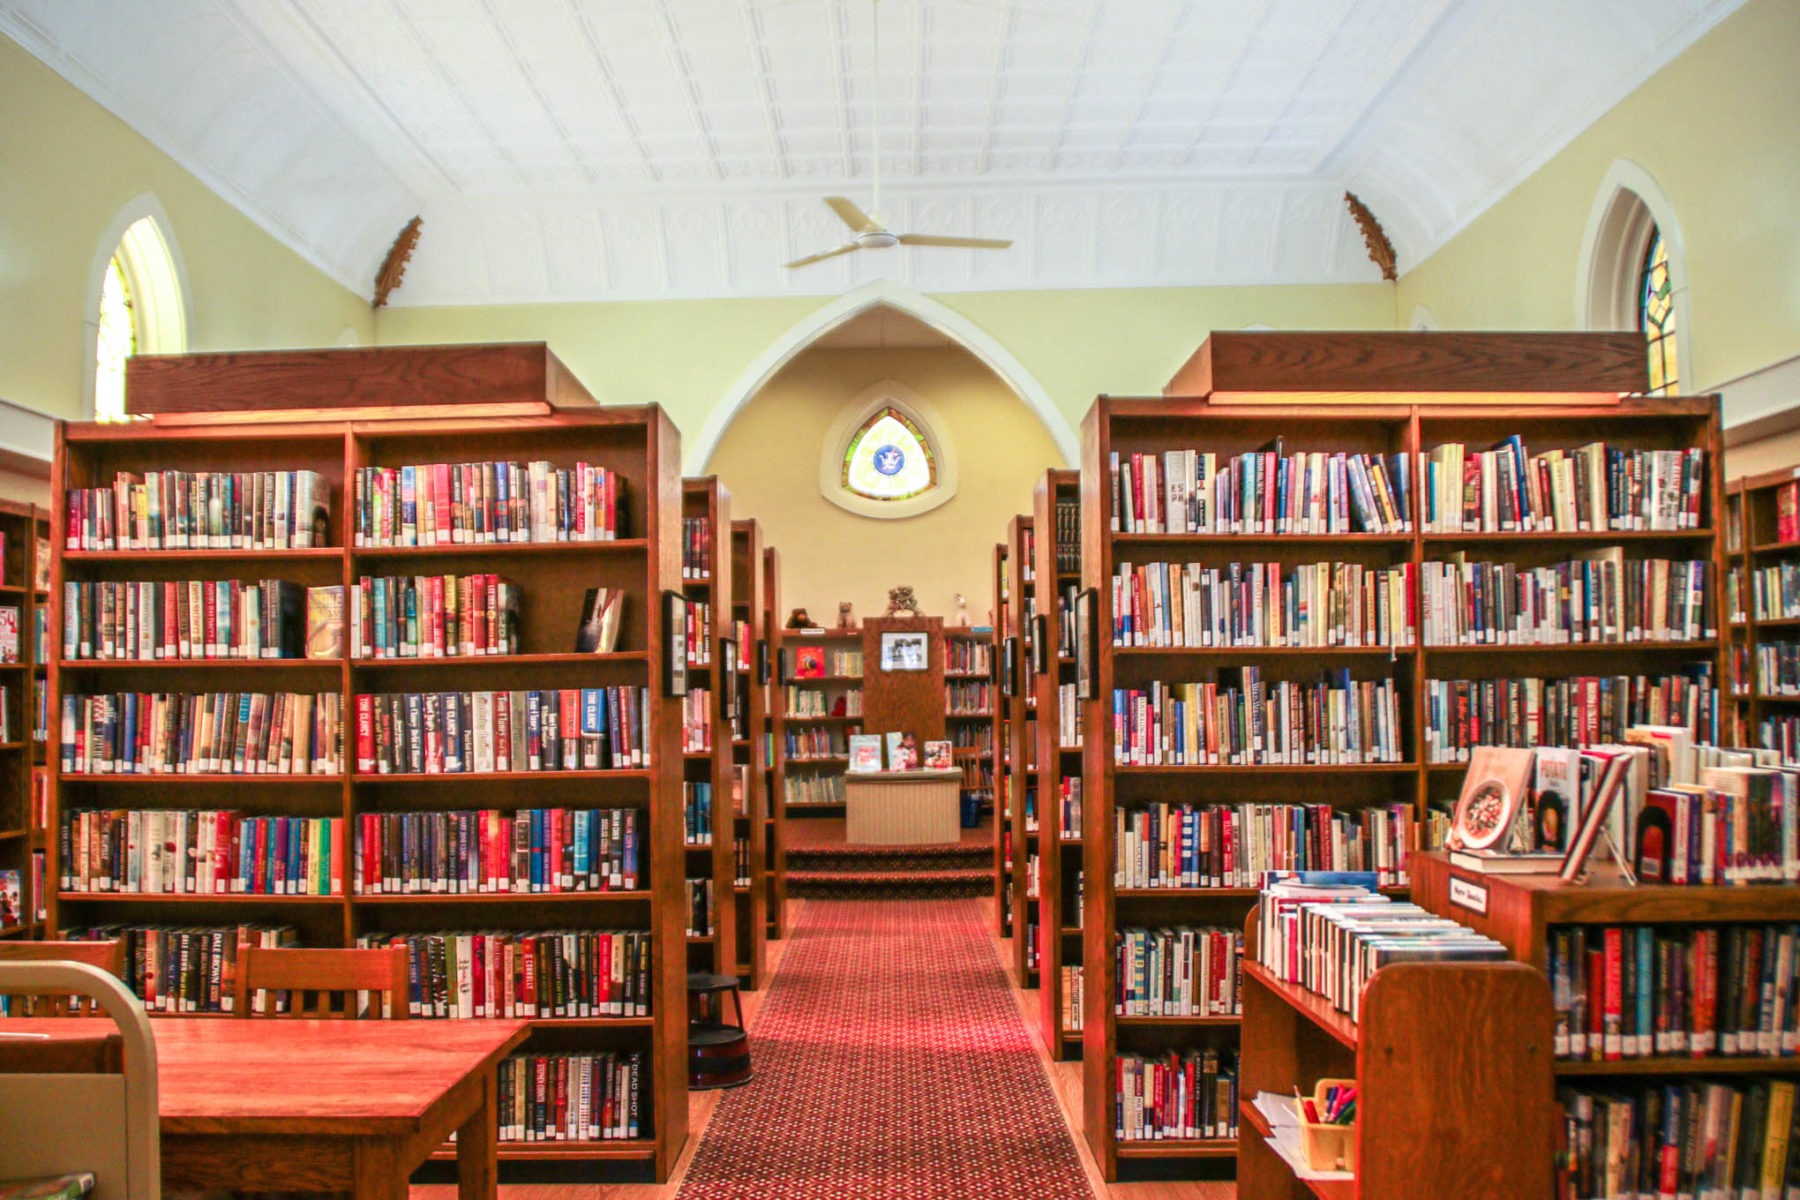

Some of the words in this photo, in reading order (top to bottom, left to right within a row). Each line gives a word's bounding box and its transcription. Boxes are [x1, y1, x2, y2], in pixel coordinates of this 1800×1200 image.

[360, 698, 369, 711] TOM
[410, 696, 418, 707] Tom
[446, 696, 456, 709] TOM
[498, 697, 508, 711] Tom
[530, 697, 539, 710] Tom
[587, 692, 596, 704] TOM
[360, 713, 369, 736] CLANCY
[408, 709, 419, 727] Clancy
[446, 711, 456, 736] CLANCY
[497, 713, 508, 736] Clancy
[528, 711, 539, 731] Clancy
[587, 705, 596, 728] CLANCY
[213, 933, 222, 952] DALE
[211, 954, 220, 983] BROWN
[537, 1064, 545, 1084] STEPHEN
[537, 1085, 545, 1103] COONTS
